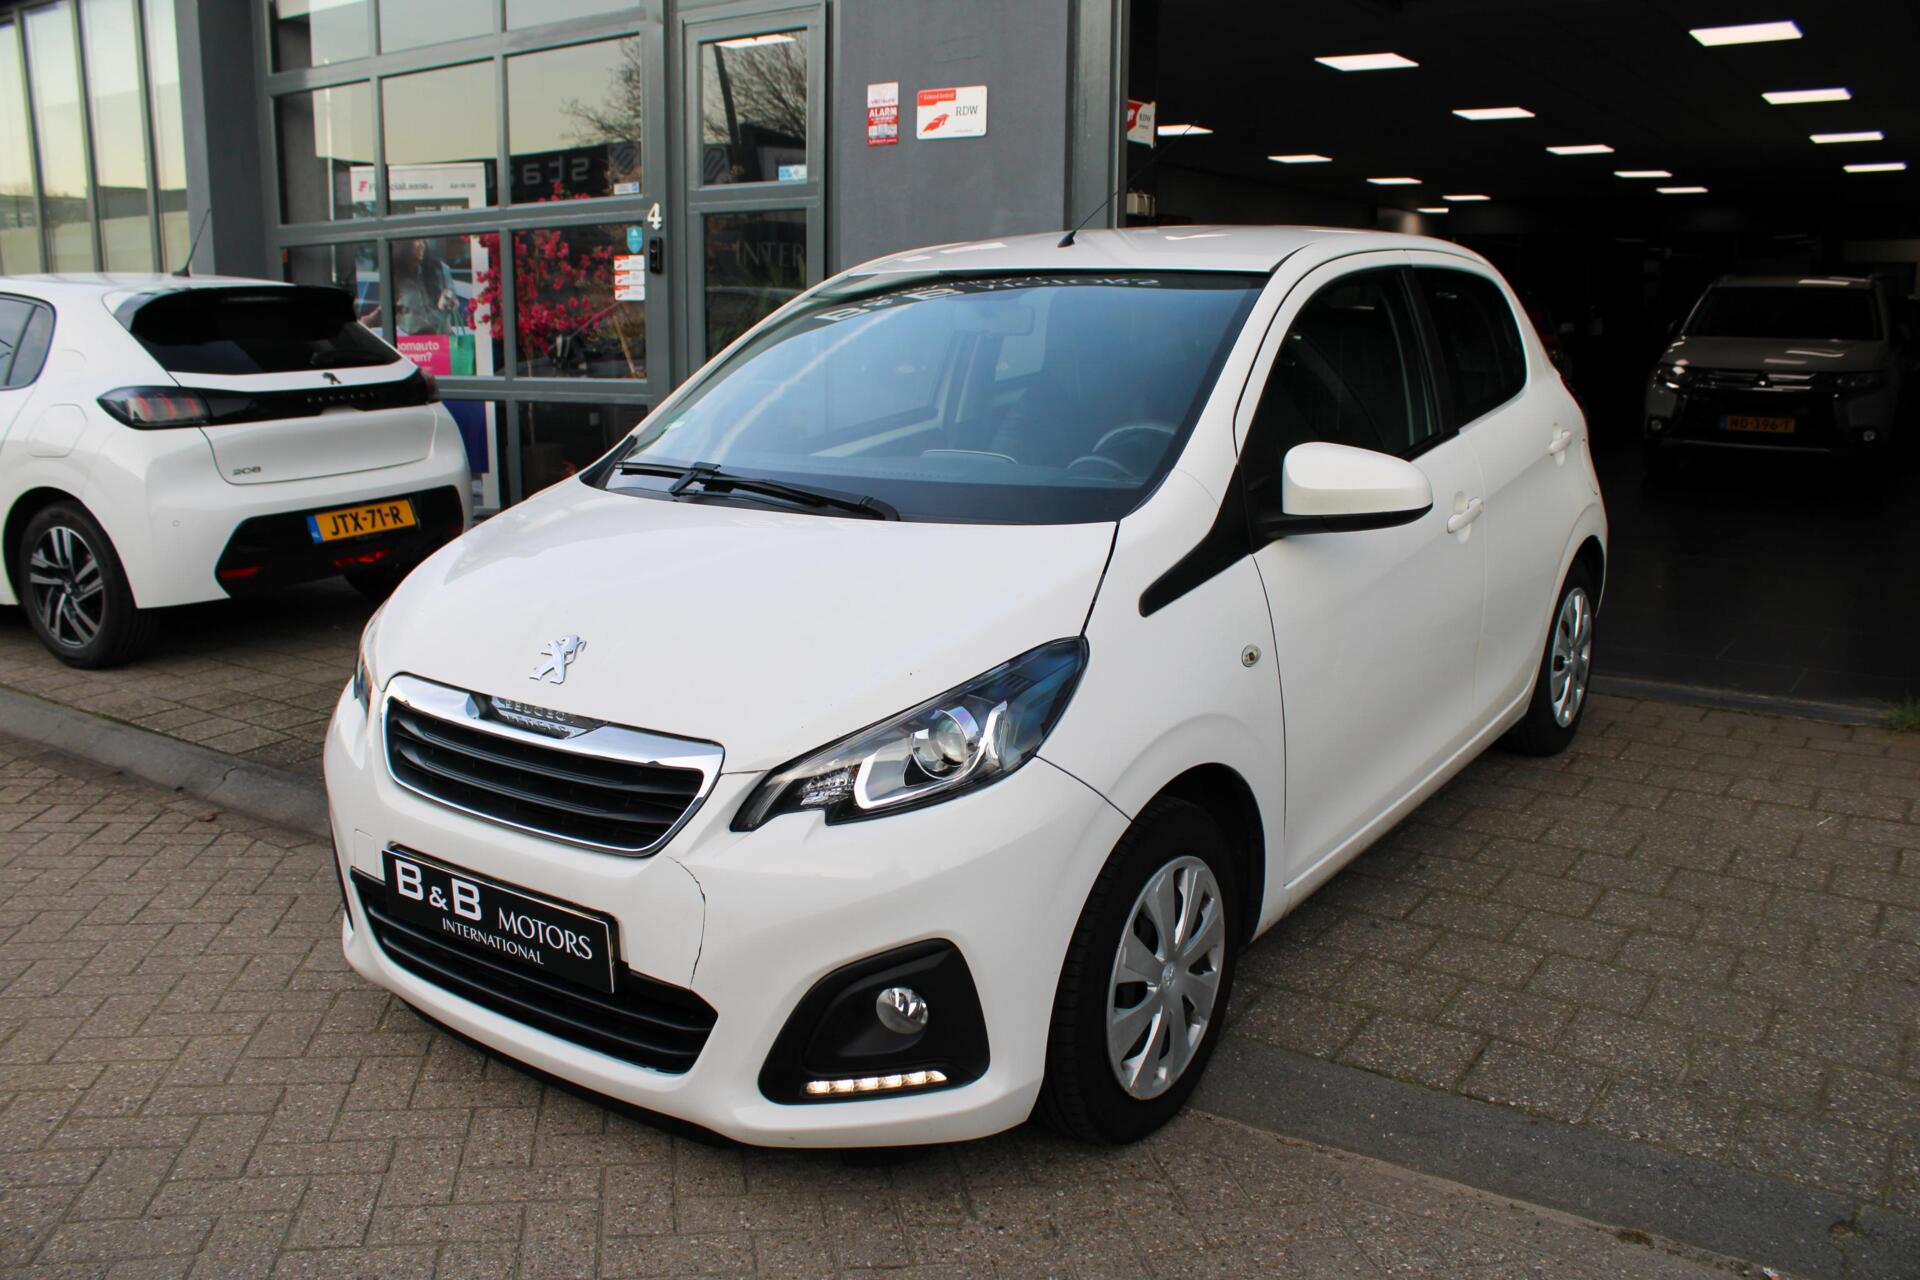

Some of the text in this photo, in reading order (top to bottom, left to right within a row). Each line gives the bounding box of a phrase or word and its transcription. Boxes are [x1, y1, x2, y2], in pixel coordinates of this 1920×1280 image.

[868, 107, 898, 118] ALARM
[955, 105, 979, 117] RDW
[647, 202, 663, 231] 4
[232, 465, 262, 476] 208
[331, 505, 404, 536] JTX-71-R
[395, 858, 594, 961] B & B MOTORS
[441, 917, 545, 966] INTERNATIONAL
